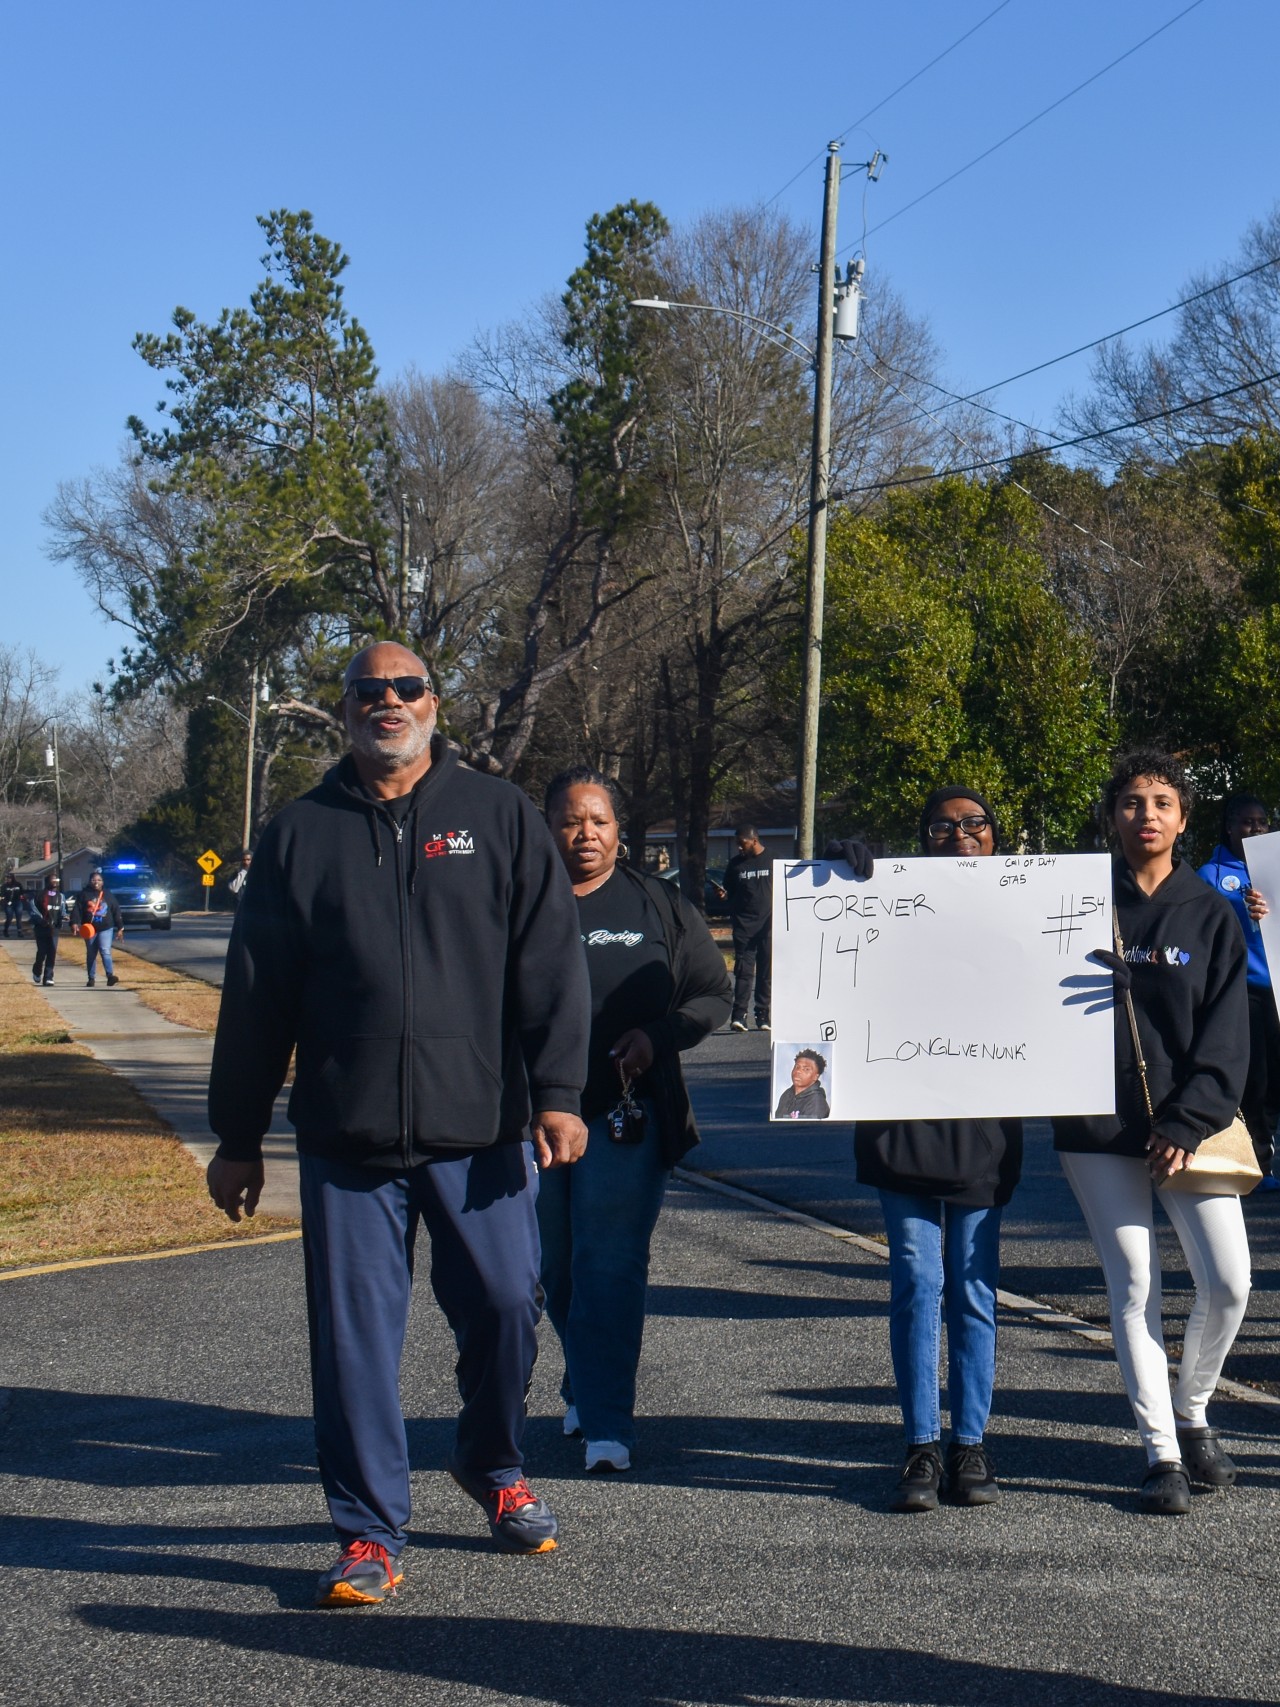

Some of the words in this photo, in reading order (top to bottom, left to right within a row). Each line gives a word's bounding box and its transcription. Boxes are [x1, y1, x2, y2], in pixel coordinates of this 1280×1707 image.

[956, 860, 979, 868] WWE
[999, 874, 1027, 887] GTA5
[784, 863, 936, 932] FOREVER
[587, 929, 644, 947] Racing
[1041, 893, 1106, 955] #54
[816, 931, 860, 1000] 14
